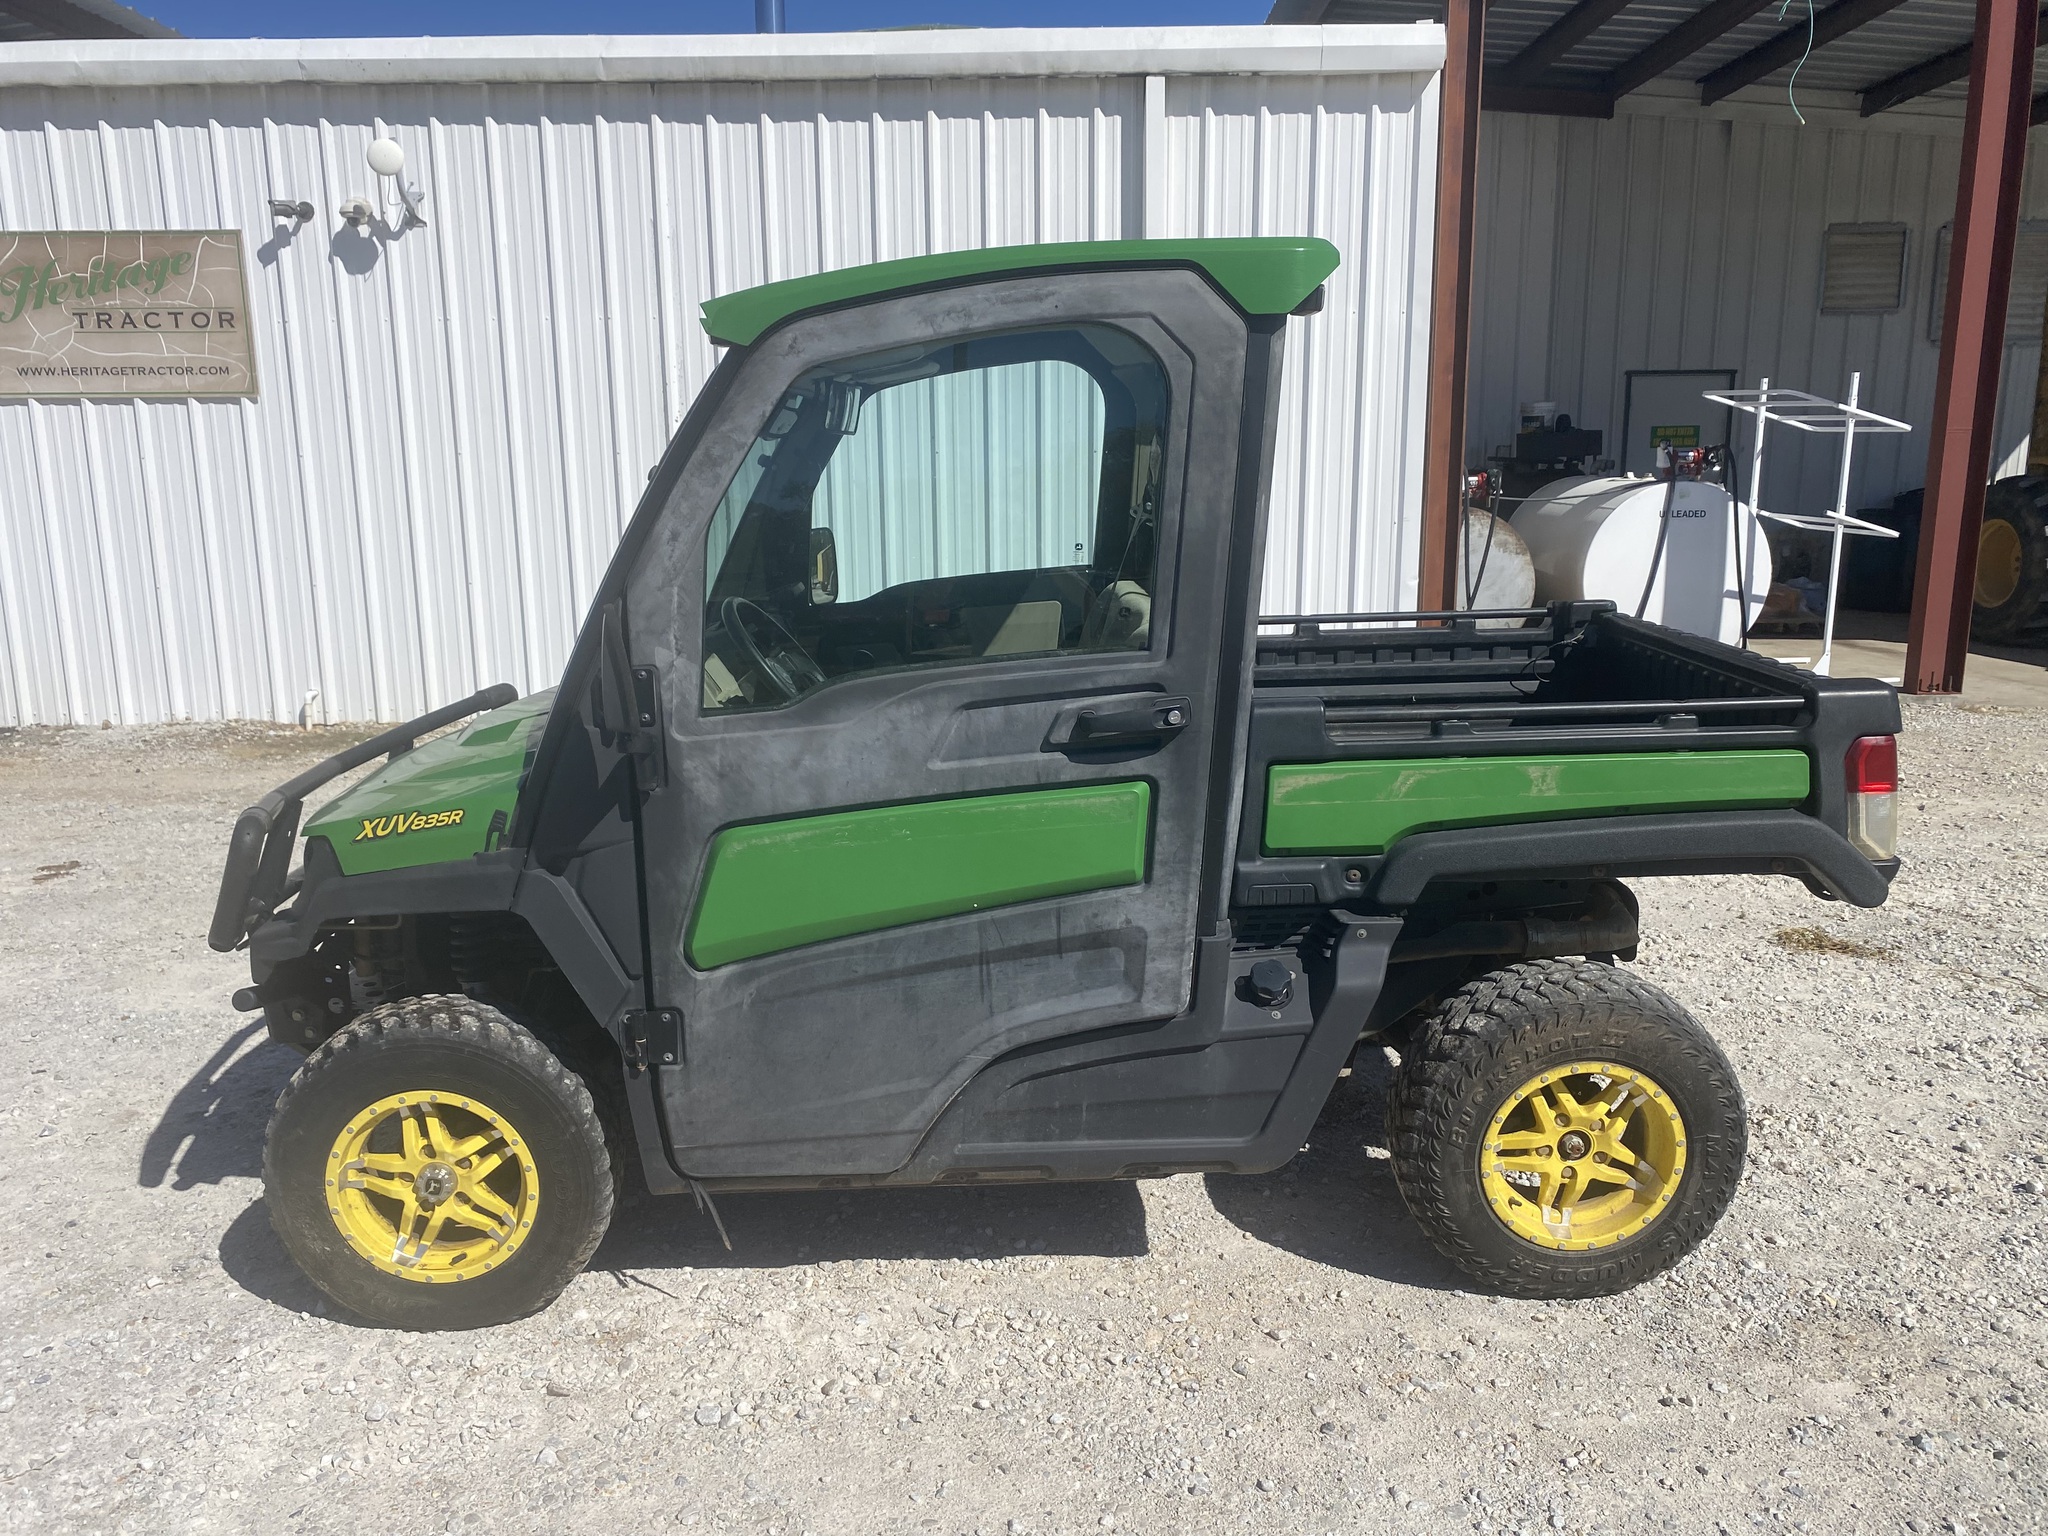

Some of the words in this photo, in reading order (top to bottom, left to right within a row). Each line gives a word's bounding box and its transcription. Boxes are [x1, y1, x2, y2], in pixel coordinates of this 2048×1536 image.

[0, 251, 192, 324] Heritage
[72, 311, 236, 329] TRACTOR
[16, 365, 230, 377] WWW.HERITAGETRACTOR.COM
[1659, 509, 1706, 518] ULEADED
[353, 808, 465, 841] XUV835R
